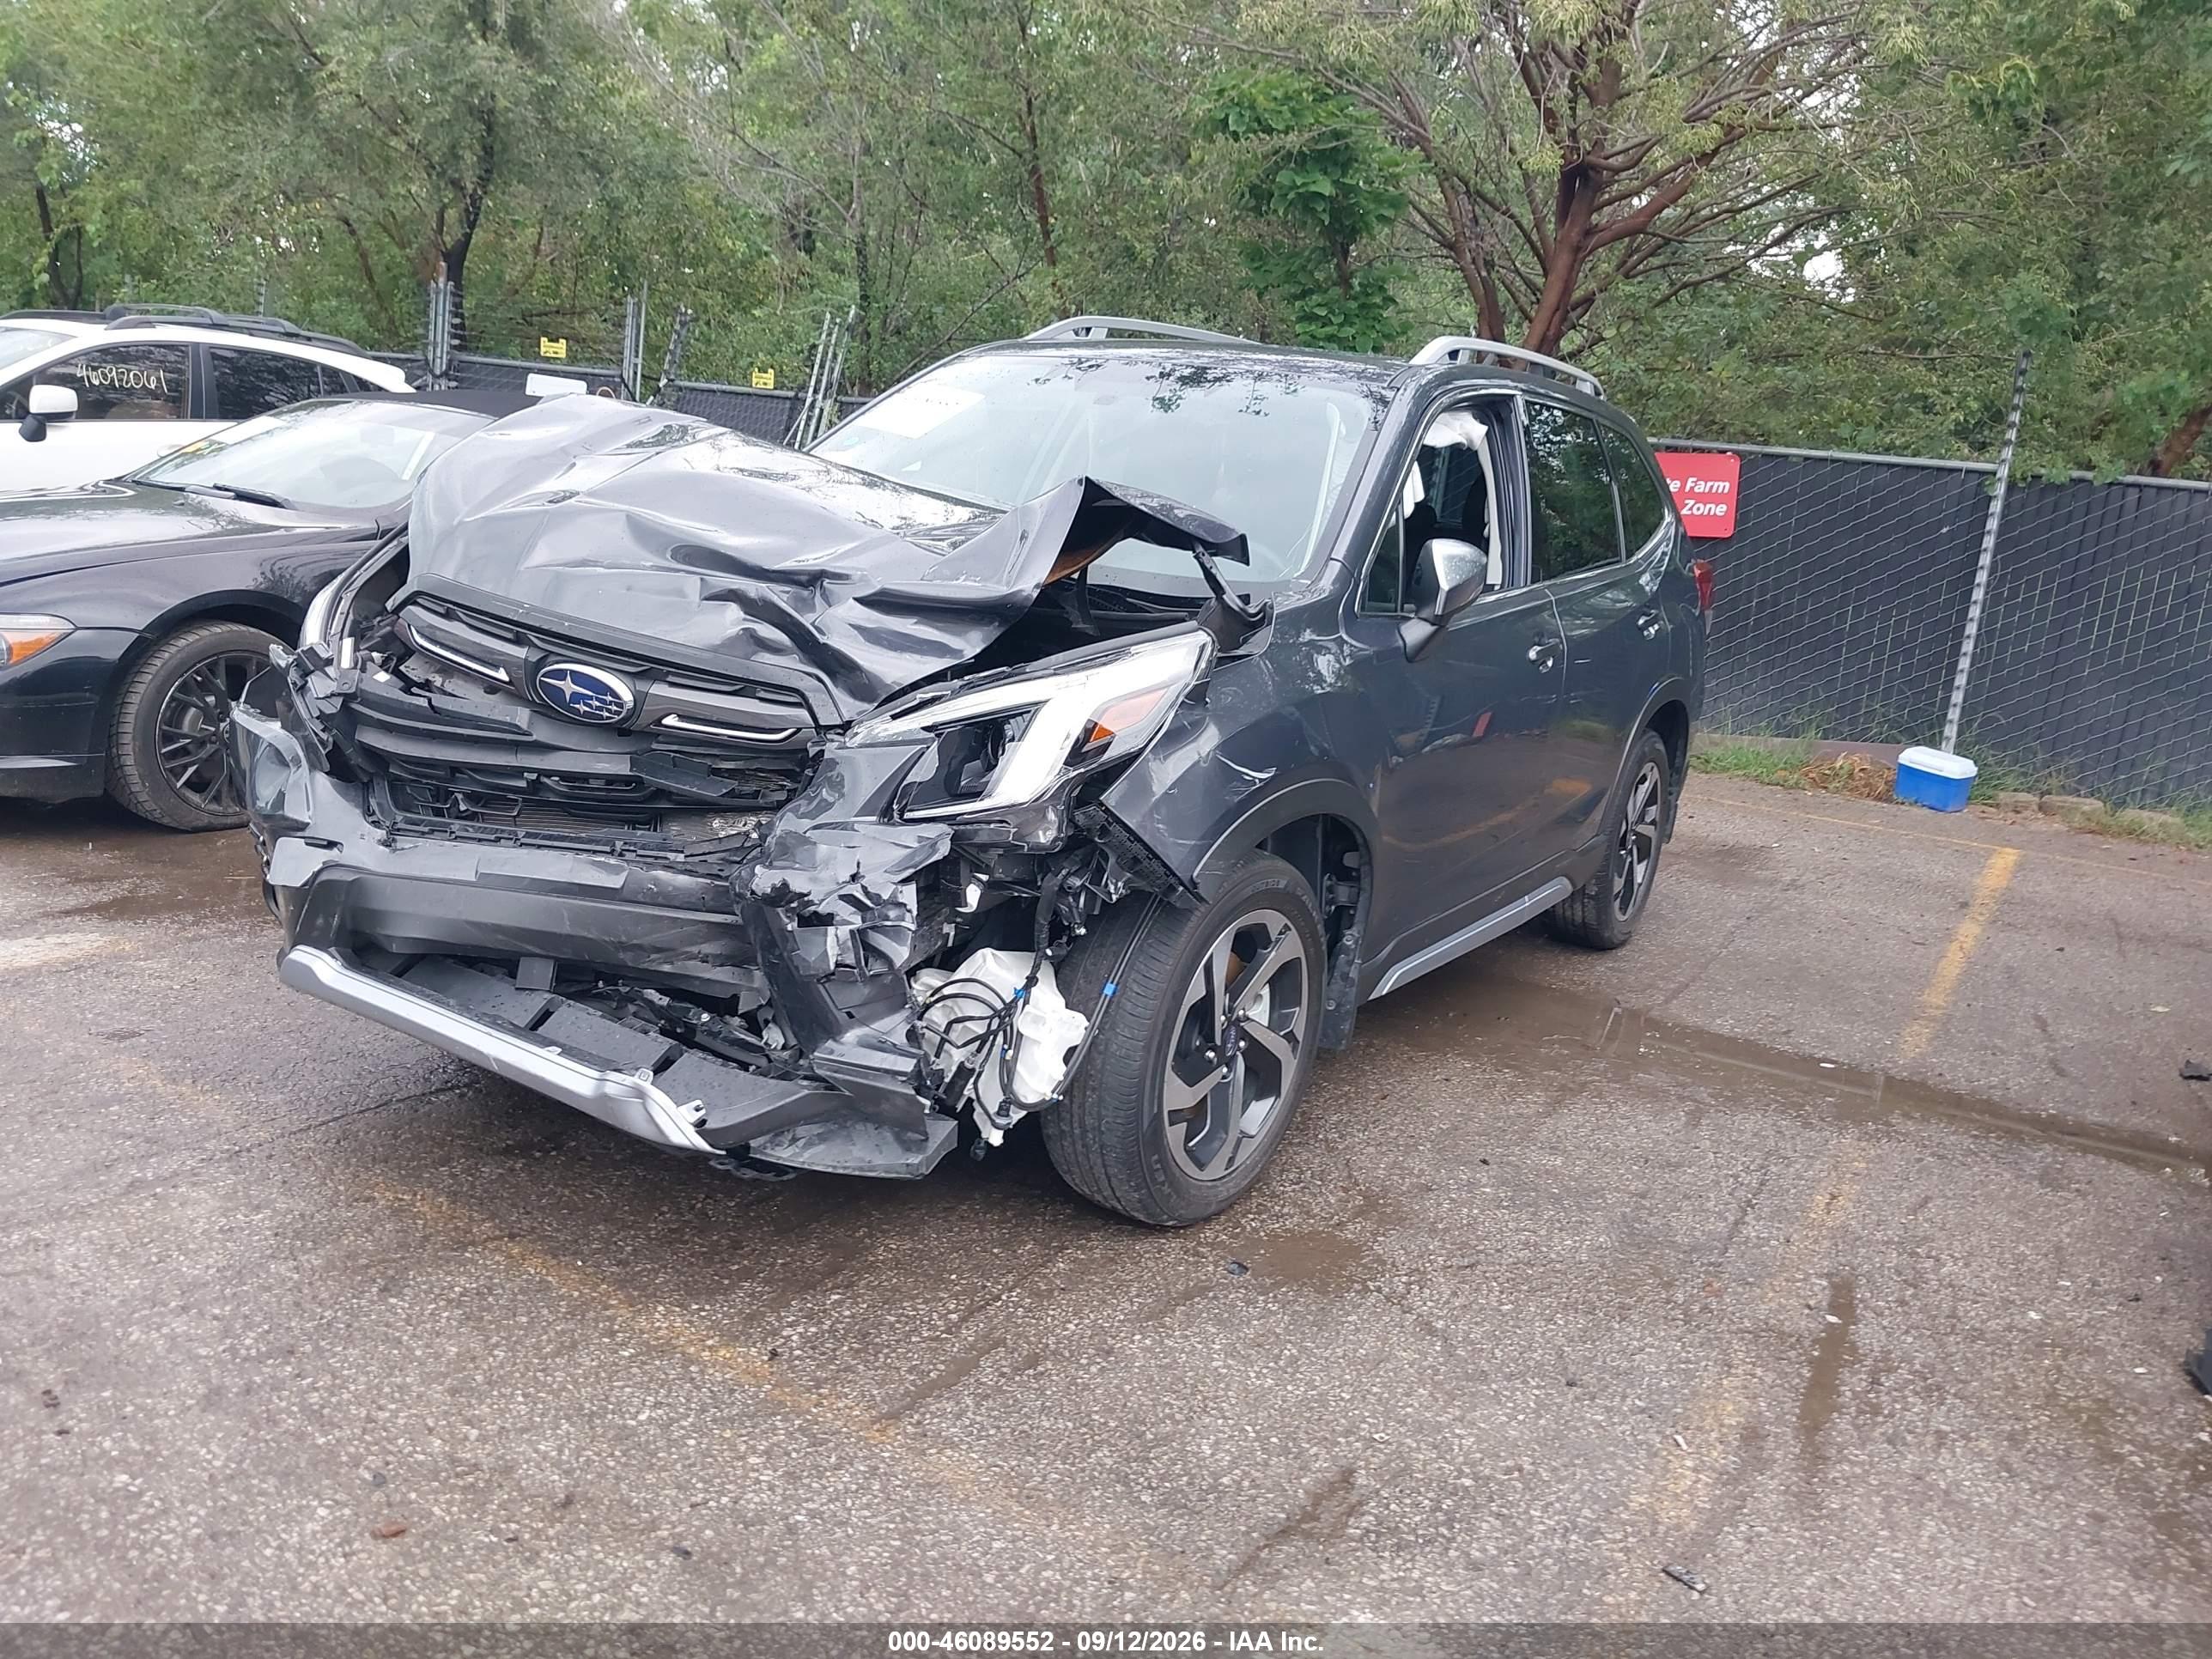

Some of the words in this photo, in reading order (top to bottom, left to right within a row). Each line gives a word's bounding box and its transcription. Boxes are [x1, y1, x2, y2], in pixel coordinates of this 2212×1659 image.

[76, 362, 168, 394] 46092061
[1685, 477, 1730, 494] Farm
[1680, 499, 1728, 517] Zone
